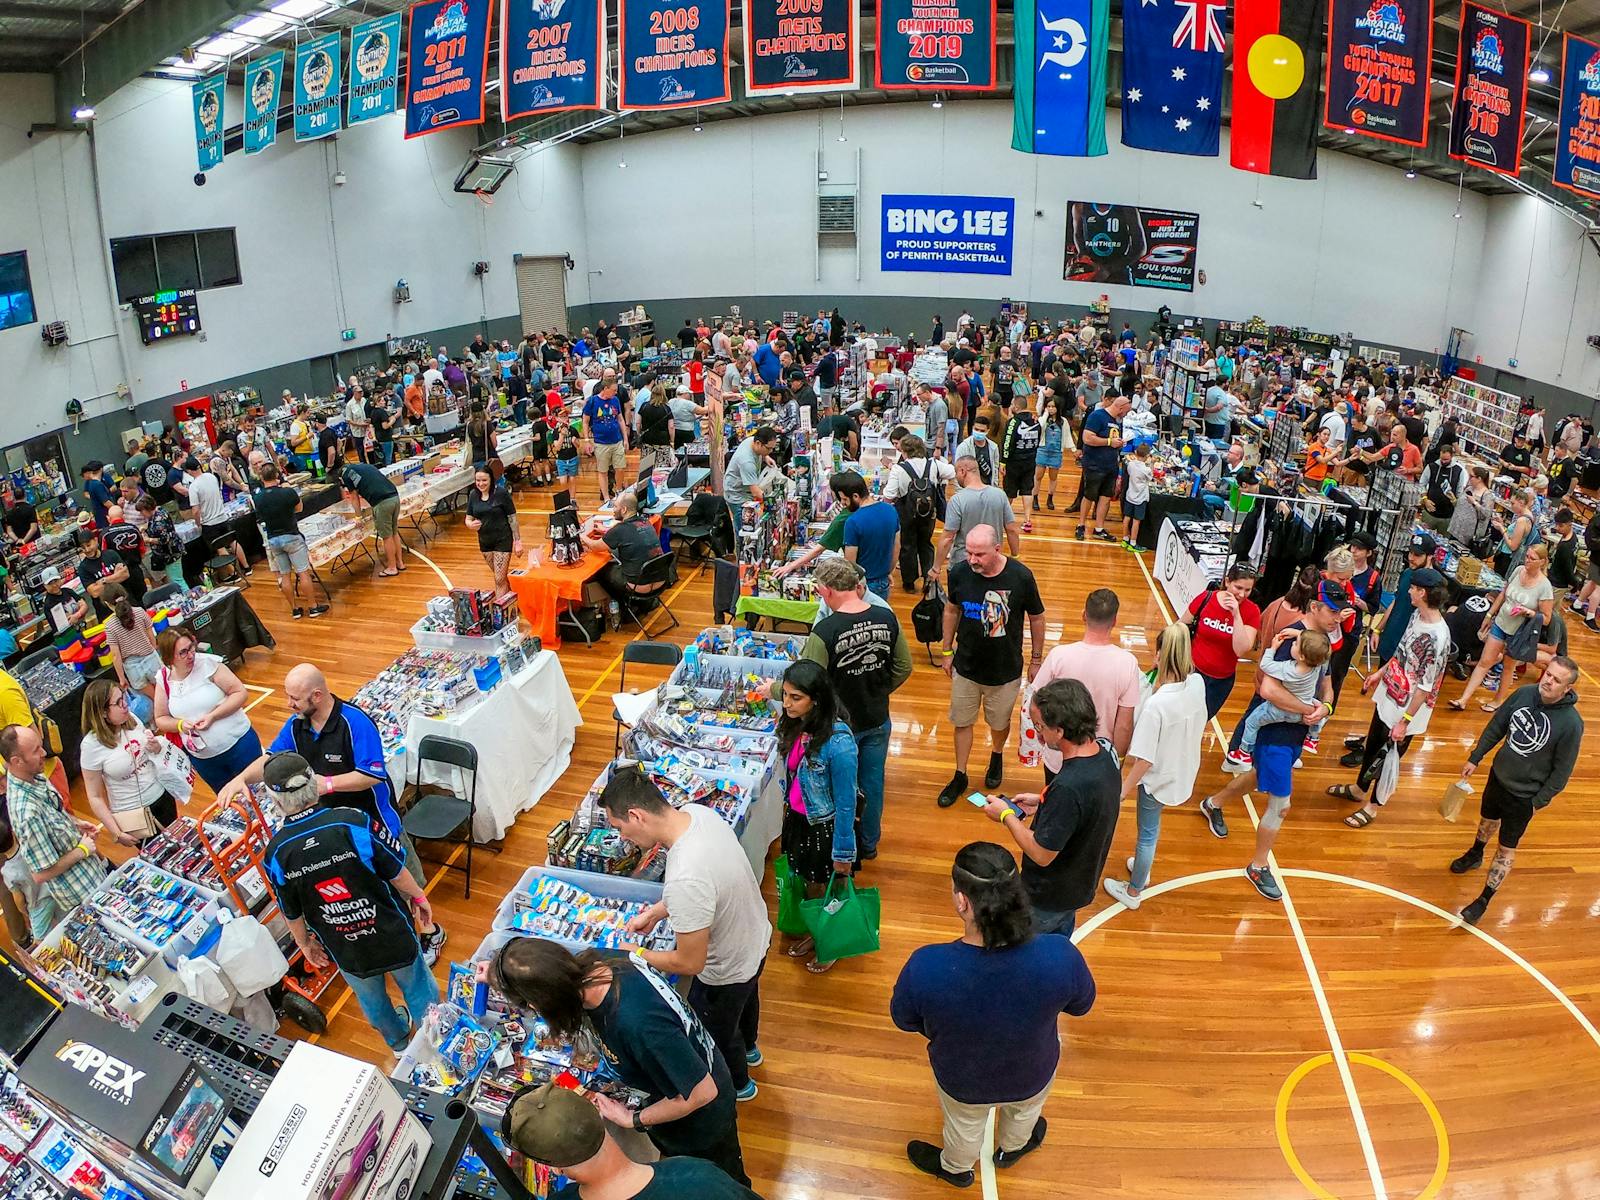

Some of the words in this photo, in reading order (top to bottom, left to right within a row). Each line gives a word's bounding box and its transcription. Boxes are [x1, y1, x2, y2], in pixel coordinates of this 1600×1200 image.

[649, 6, 700, 34] 2008
[912, 7, 940, 18] YOUTH
[940, 8, 959, 18] MEN
[436, 22, 468, 41] LEAGUE
[526, 22, 571, 50] 2007
[779, 17, 822, 36] MENS
[897, 18, 974, 34] CHAMPIONS
[1354, 18, 1404, 34] WARATAH
[1369, 28, 1406, 44] LEAGUE
[424, 35, 466, 66] 2011
[656, 34, 696, 54] MENS
[756, 33, 846, 56] CHAMPIONS
[909, 34, 962, 59] 2019
[531, 46, 567, 66] MENS
[635, 48, 717, 73] CHAMPIONS
[1349, 44, 1377, 60] YOUTH
[1379, 51, 1413, 68] WOMEN
[513, 59, 586, 84] CHAMPIONS
[1343, 54, 1416, 85] CHAMPIONS
[413, 78, 471, 104] CHAMPIONS
[1356, 76, 1402, 107] 2017
[1367, 114, 1396, 126] Basketball
[886, 208, 957, 235] BING
[962, 209, 1009, 237] LEE
[1106, 218, 1119, 232] 10
[1173, 220, 1194, 228] THAN
[1086, 240, 1121, 248] PANTHERS
[1150, 231, 1190, 239] UNIFORM!
[896, 240, 930, 250] PROUD
[933, 241, 996, 252] SUPPORTERS
[886, 250, 899, 260] OF
[901, 251, 945, 262] PENRITH
[946, 252, 1007, 264] BASKETBALL
[1138, 264, 1160, 272] SOUL
[1161, 265, 1192, 274] SPORTS
[139, 296, 154, 304] LIGHT
[179, 289, 195, 298] DARK
[154, 326, 161, 337] 0
[189, 320, 196, 330] 0
[1029, 329, 1039, 338] 19
[1203, 615, 1234, 634] adida
[835, 631, 870, 654] GRAND
[872, 630, 891, 642] PRIX
[290, 808, 314, 821] VOLVO
[284, 869, 302, 880] Volvo
[302, 857, 332, 874] Polestar
[319, 897, 369, 915] Wilson
[322, 904, 376, 925] Security
[335, 919, 375, 932] RACING
[59, 1041, 146, 1098] APEX
[186, 1068, 196, 1081] SCALE
[88, 1078, 131, 1106] REPLICAS
[144, 1115, 168, 1150] APEX
[270, 1107, 301, 1157] CLASSIC
[275, 1110, 304, 1160] CARLECTABLES
[301, 1152, 322, 1186] HOLDEN
[325, 1106, 346, 1140] TORANA
[356, 1068, 367, 1084] GTR
[315, 1159, 334, 1194] HOLDEN
[338, 1114, 358, 1147] TORANA
[368, 1076, 378, 1092] GTR
